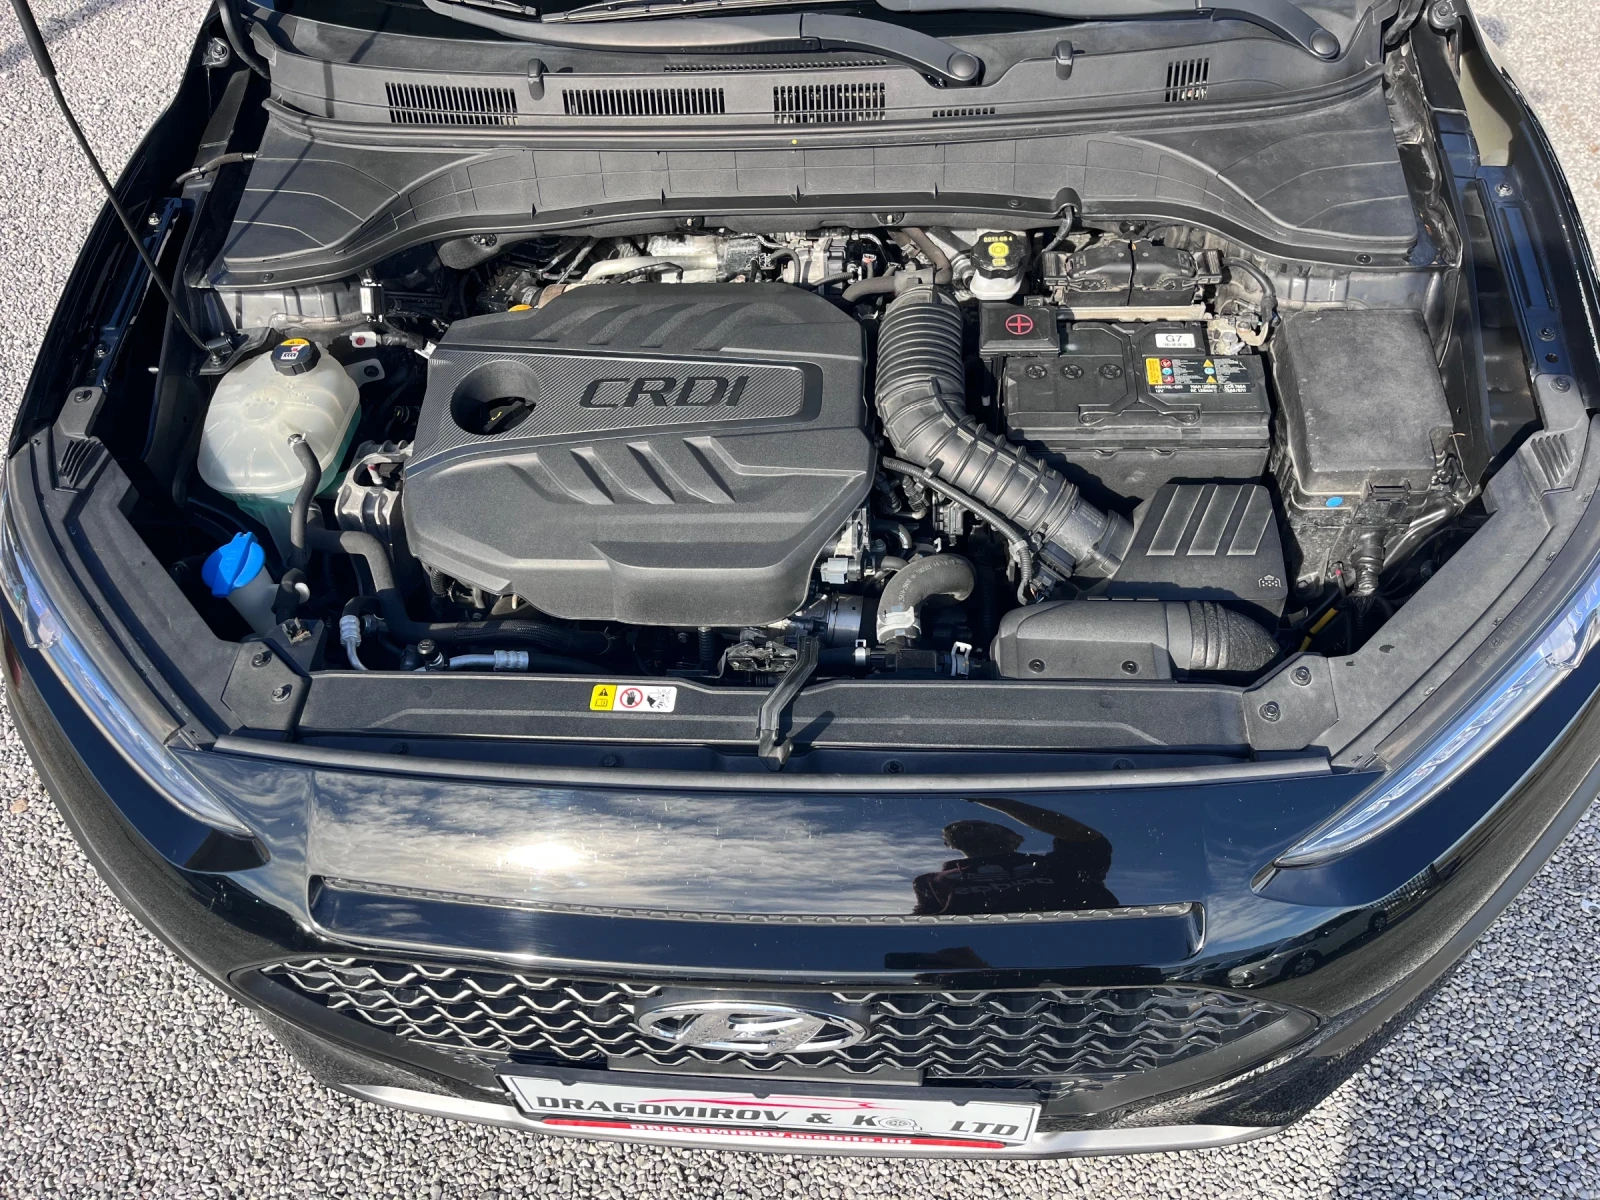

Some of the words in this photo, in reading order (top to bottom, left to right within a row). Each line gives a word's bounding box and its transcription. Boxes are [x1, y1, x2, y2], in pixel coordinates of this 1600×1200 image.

[1165, 334, 1182, 342] G7
[579, 376, 750, 409] CRDI
[536, 1096, 789, 1121] DRAGOMIROV
[806, 1113, 834, 1125] &
[950, 1120, 1020, 1136] LTD
